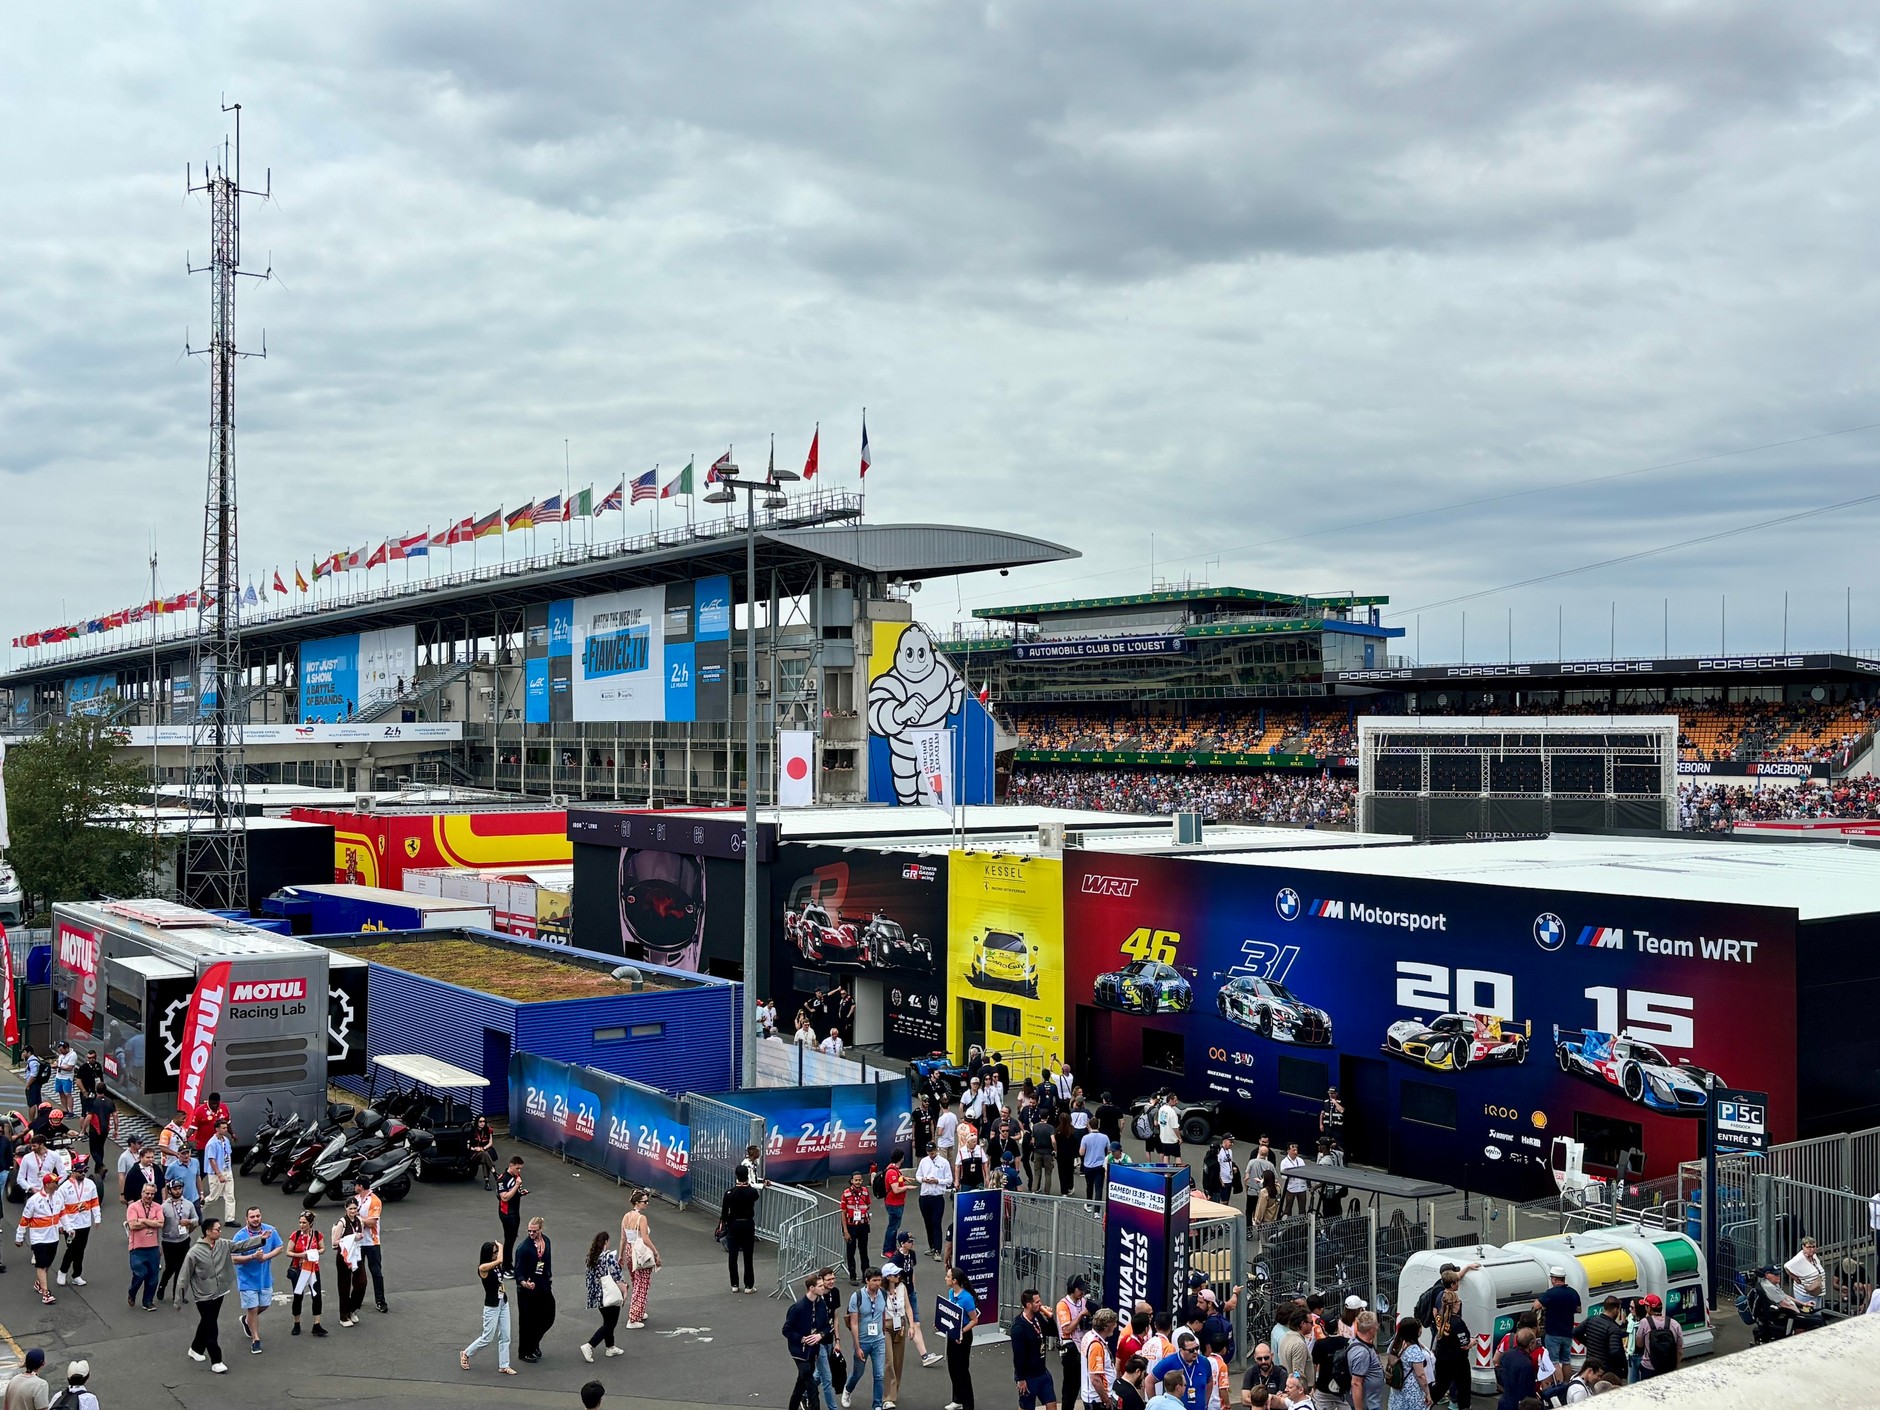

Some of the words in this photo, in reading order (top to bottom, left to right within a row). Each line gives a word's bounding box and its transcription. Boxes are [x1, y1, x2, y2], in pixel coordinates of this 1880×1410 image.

[610, 612, 618, 628] THE
[631, 609, 642, 625] LIVE
[589, 634, 649, 674] FIAWEC.TV
[1029, 646, 1084, 657] AUTOMOBILE
[1086, 644, 1110, 654] CLUB
[1112, 644, 1124, 652] DE
[1127, 640, 1166, 651] L'OUEST
[306, 661, 318, 672] NOT
[319, 659, 338, 671] JUST
[1448, 666, 1530, 676] PORSCHE
[1561, 662, 1653, 673] PORSCHE
[1698, 658, 1804, 669] PORSCHE
[1339, 670, 1412, 680] PORSCHE
[1757, 764, 1812, 775] RACEBORN
[902, 870, 917, 878] GR
[985, 865, 1023, 878] KESSEL
[1082, 874, 1138, 897] WRT
[1350, 902, 1446, 932] Motorsport
[60, 930, 94, 974] MOTUL
[1120, 927, 1180, 966] 46
[1633, 930, 1694, 957] Team
[1700, 937, 1758, 964] WRT
[1227, 940, 1300, 984] 31
[233, 982, 303, 1000] MOTUL
[1396, 961, 1513, 1022] 20
[230, 1006, 278, 1019] Racing
[282, 1003, 306, 1015] Lab
[1585, 986, 1693, 1048] 15
[184, 985, 224, 1110] MOTUL
[1209, 1047, 1227, 1062] OQ
[526, 1087, 547, 1112] 24h
[531, 1109, 546, 1118] MANS
[576, 1103, 594, 1130] 24h
[1485, 1104, 1518, 1120] iQOO
[1722, 1104, 1733, 1118] P
[1739, 1106, 1760, 1123] 5c
[582, 1126, 594, 1136] MANS
[609, 1116, 630, 1143] 24h
[615, 1140, 630, 1150] MANS
[638, 1125, 660, 1153] 24h
[858, 1140, 868, 1148] LE
[895, 1135, 905, 1143] LE
[1718, 1133, 1748, 1143] ENTRÉE
[644, 1150, 660, 1160] MANS
[666, 1136, 688, 1164] 24h
[671, 1161, 688, 1172] MANS
[1110, 1184, 1131, 1196] SAMEDI
[1110, 1192, 1131, 1204] SATURDAY
